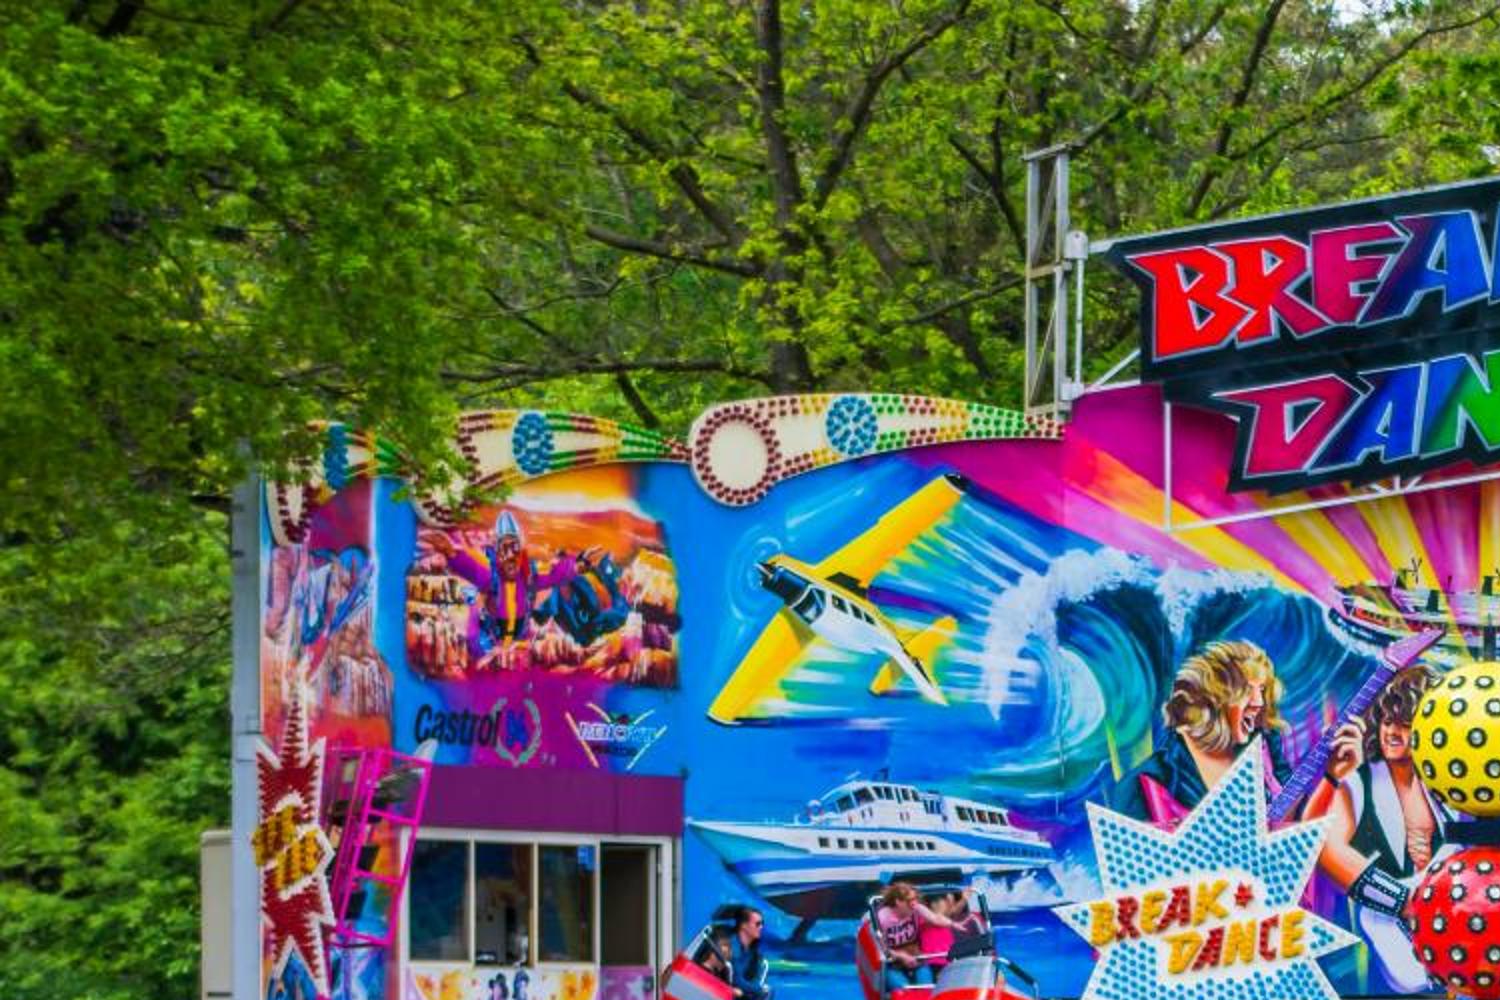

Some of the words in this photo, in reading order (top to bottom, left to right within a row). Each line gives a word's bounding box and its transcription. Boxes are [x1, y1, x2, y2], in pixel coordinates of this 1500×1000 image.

[414, 703, 502, 747] Castrol
[1089, 879, 1230, 947] BREAK
[1162, 911, 1306, 975] DANCE
